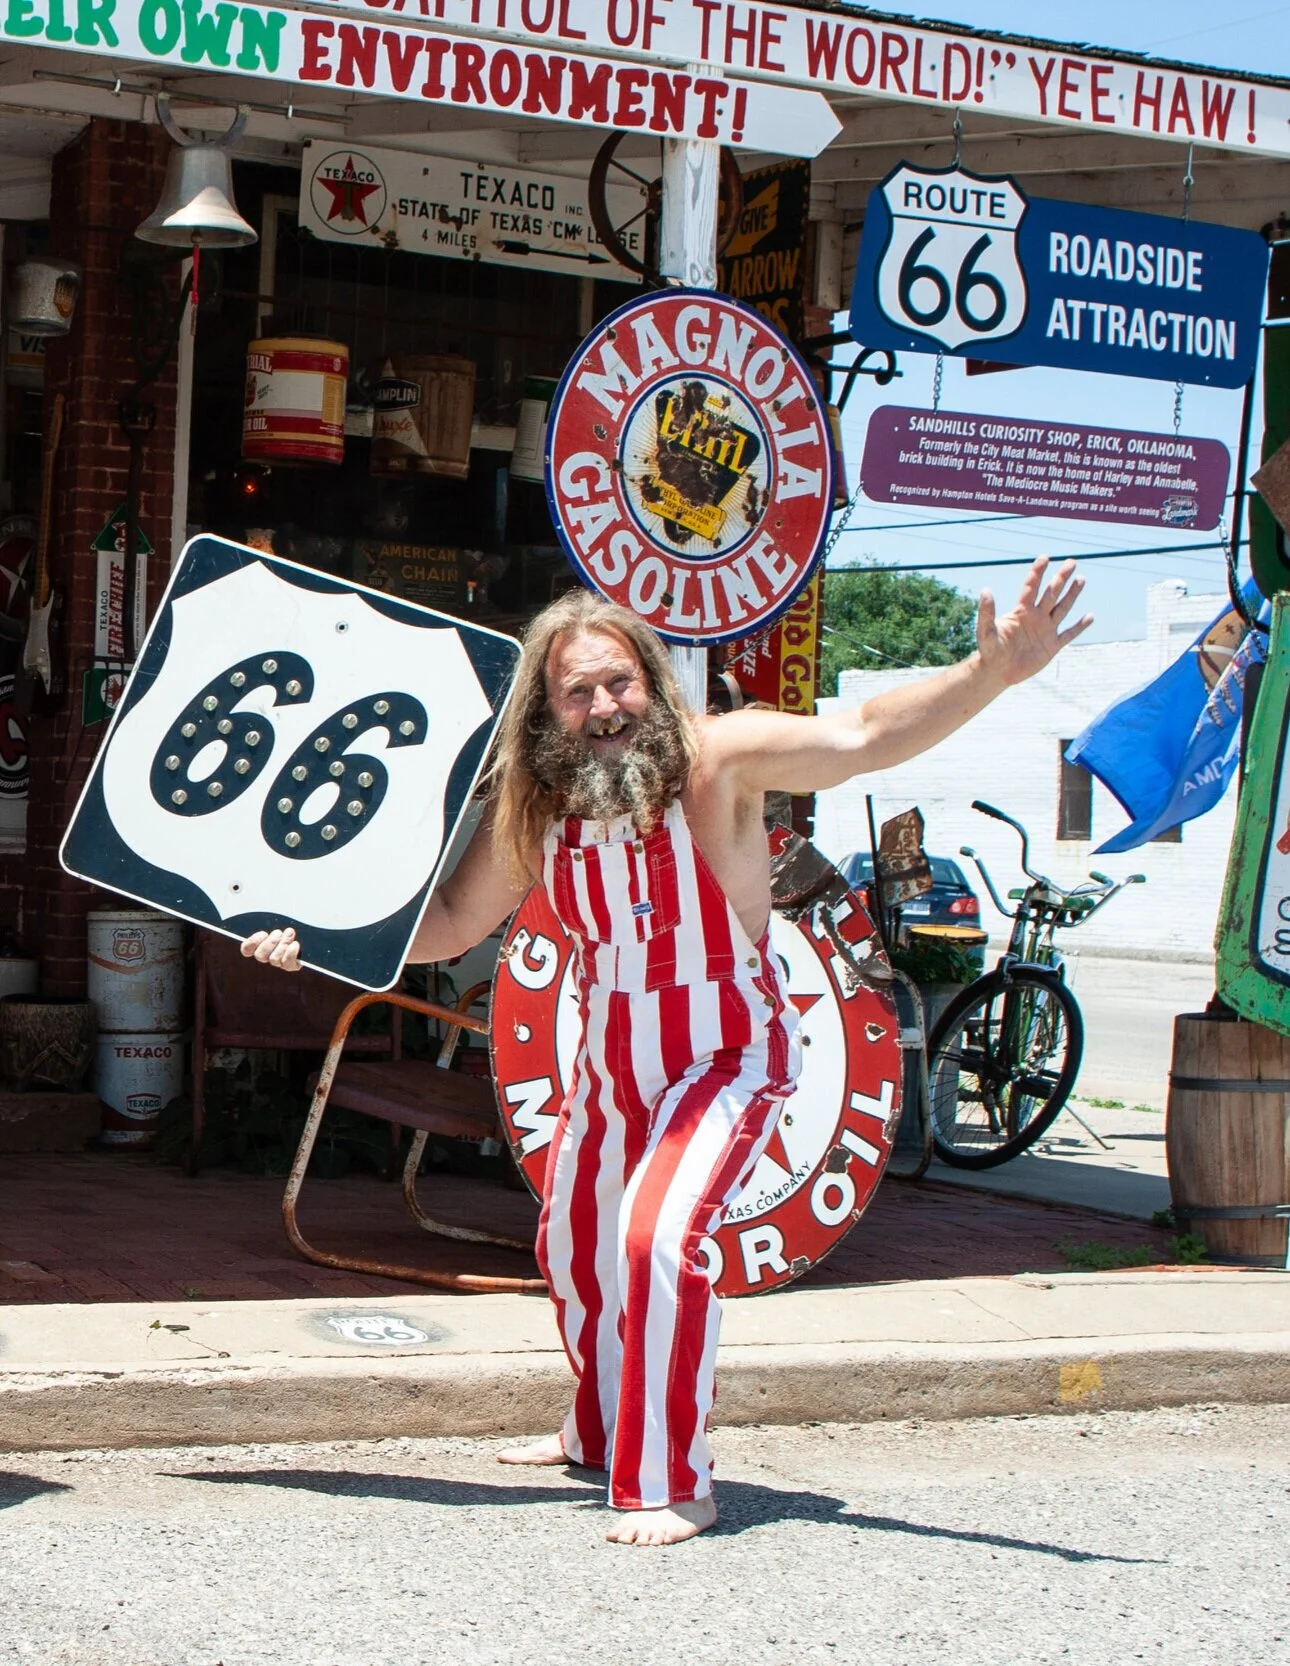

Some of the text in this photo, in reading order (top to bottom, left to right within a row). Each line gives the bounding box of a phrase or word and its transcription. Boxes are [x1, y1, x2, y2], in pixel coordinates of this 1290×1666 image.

[607, 0, 673, 50] OF
[694, 1, 788, 72] THE
[3, 0, 748, 143] EIR OWN ENVIRONMENT!
[1028, 55, 1117, 125] YEE
[324, 167, 375, 184] TEXACO
[459, 171, 556, 212] TEXACO
[398, 198, 450, 220] STATE
[459, 207, 481, 226] OF
[490, 211, 543, 235] TEXAS
[739, 205, 769, 235] GIVE
[902, 181, 1007, 220] ROUTE
[421, 229, 478, 249] 4 MILES
[728, 247, 801, 299] ARROW
[898, 225, 1007, 333] 66
[1048, 231, 1204, 292] ROADSIDE
[1045, 297, 1236, 361] ATTRACTION
[377, 387, 418, 402] AMPLIN
[576, 304, 822, 505] MAGNOLIA
[908, 416, 977, 437] SANDHILLS
[979, 423, 1045, 445] CURIOSITY
[1047, 430, 1083, 450] SHOP,
[1086, 434, 1123, 455] ERICK,
[898, 451, 1199, 492] brick building in Erick. It is now the home of Harley and Annabelle,
[918, 437, 1181, 475] Formerly the City Meat Market, this is known as the oldest
[890, 483, 930, 496] Recognized
[931, 487, 941, 498] by
[941, 489, 973, 501] Hampton
[974, 491, 997, 503] Hotels
[1060, 501, 1089, 513] program
[1090, 503, 1099, 512] as
[1104, 502, 1116, 513] site
[1118, 504, 1137, 516] worth
[1138, 507, 1160, 519] seeing
[1005, 475, 1048, 491] Mediocre
[1050, 480, 1078, 494] Music
[379, 543, 457, 562] AMERICAN
[559, 451, 798, 629] GASOLINE
[401, 564, 459, 583] CHAIN
[99, 590, 109, 632] TEXACO
[149, 650, 429, 861] 66
[118, 941, 139, 955] 66
[114, 1046, 173, 1059] TEXACO
[128, 1097, 162, 1109] TEXACO
[809, 1079, 895, 1228] OIL
[726, 1160, 812, 1221] XAS COMPANY
[352, 1326, 415, 1341] 66
